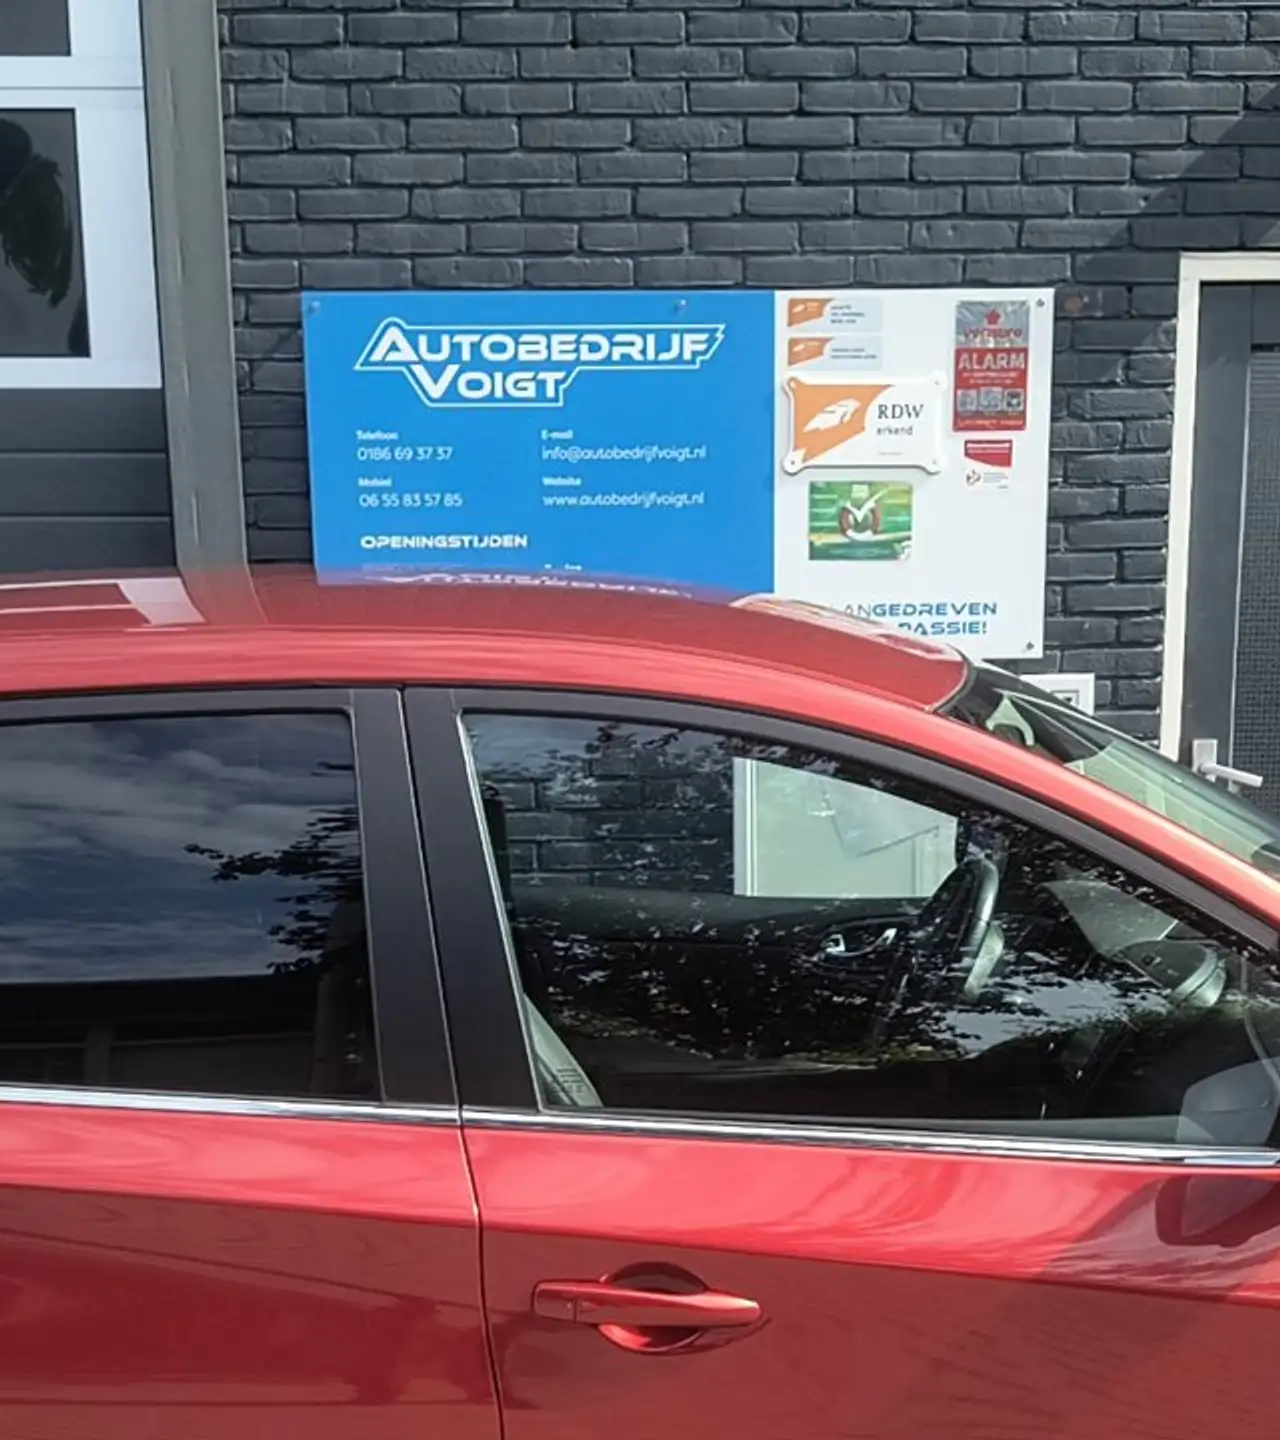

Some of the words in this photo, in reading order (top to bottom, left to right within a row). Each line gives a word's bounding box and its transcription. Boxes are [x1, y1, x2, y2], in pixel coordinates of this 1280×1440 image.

[368, 325, 710, 362] AUTOBEDRIJF
[958, 352, 1026, 370] ALARM
[411, 363, 567, 400] VOIGT
[877, 403, 924, 420] RDW
[876, 425, 914, 436] erkend
[357, 447, 392, 461] 0186
[394, 447, 414, 461] 69
[542, 445, 706, 463] info@autobedrijfvoigt.nl
[359, 493, 379, 508] 06
[402, 493, 421, 507] 83
[444, 492, 463, 507] 85
[543, 491, 704, 508] www.autobedrijfvoigt.nl
[360, 534, 528, 549] OPENINGSTIJDEN
[844, 602, 998, 617] ANGEDREVEN
